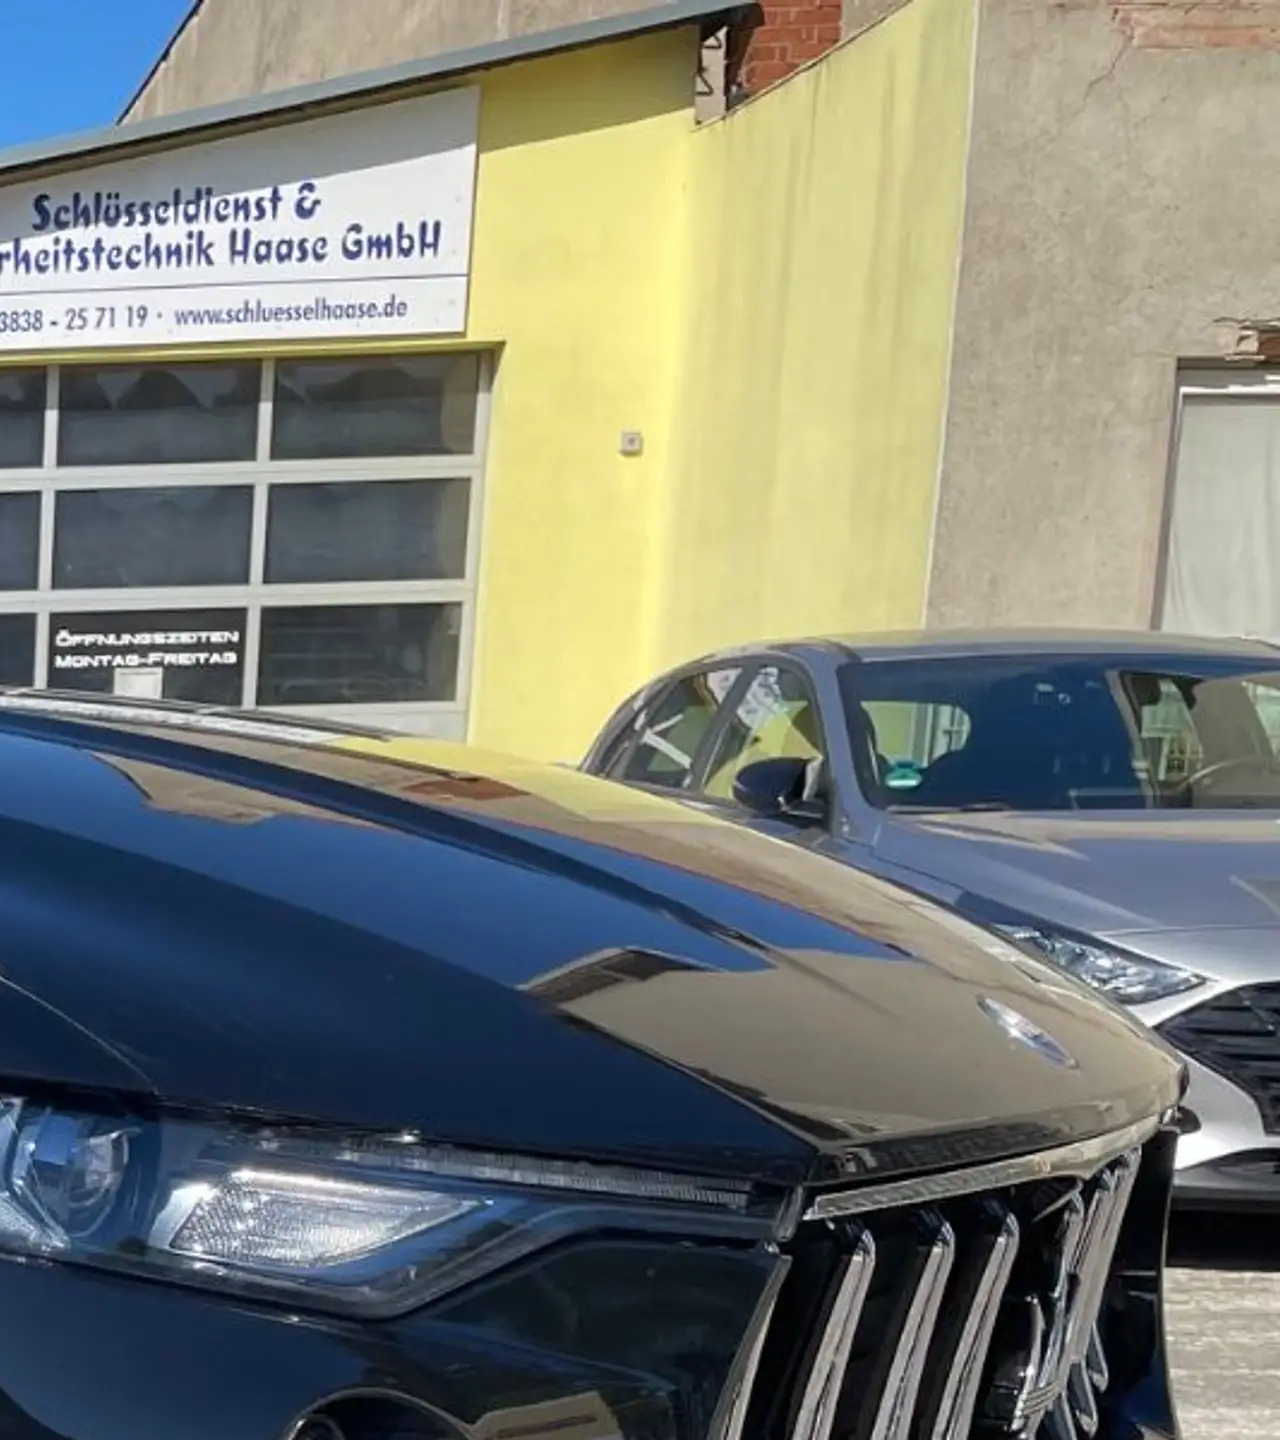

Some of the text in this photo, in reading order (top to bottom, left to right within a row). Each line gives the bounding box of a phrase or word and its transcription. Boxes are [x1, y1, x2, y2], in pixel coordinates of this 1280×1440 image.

[32, 181, 321, 232] Schlüsseldienst &
[229, 228, 328, 265] Haase
[341, 220, 441, 261] GmbH
[66, 308, 88, 330] 25
[96, 307, 116, 328] 71
[127, 305, 148, 328] 19
[175, 294, 408, 325] www.schluesselhaase.de
[55, 629, 240, 647] ÖFFNUNGSZEITEN
[54, 652, 238, 668] MONTAG-FREITAG
